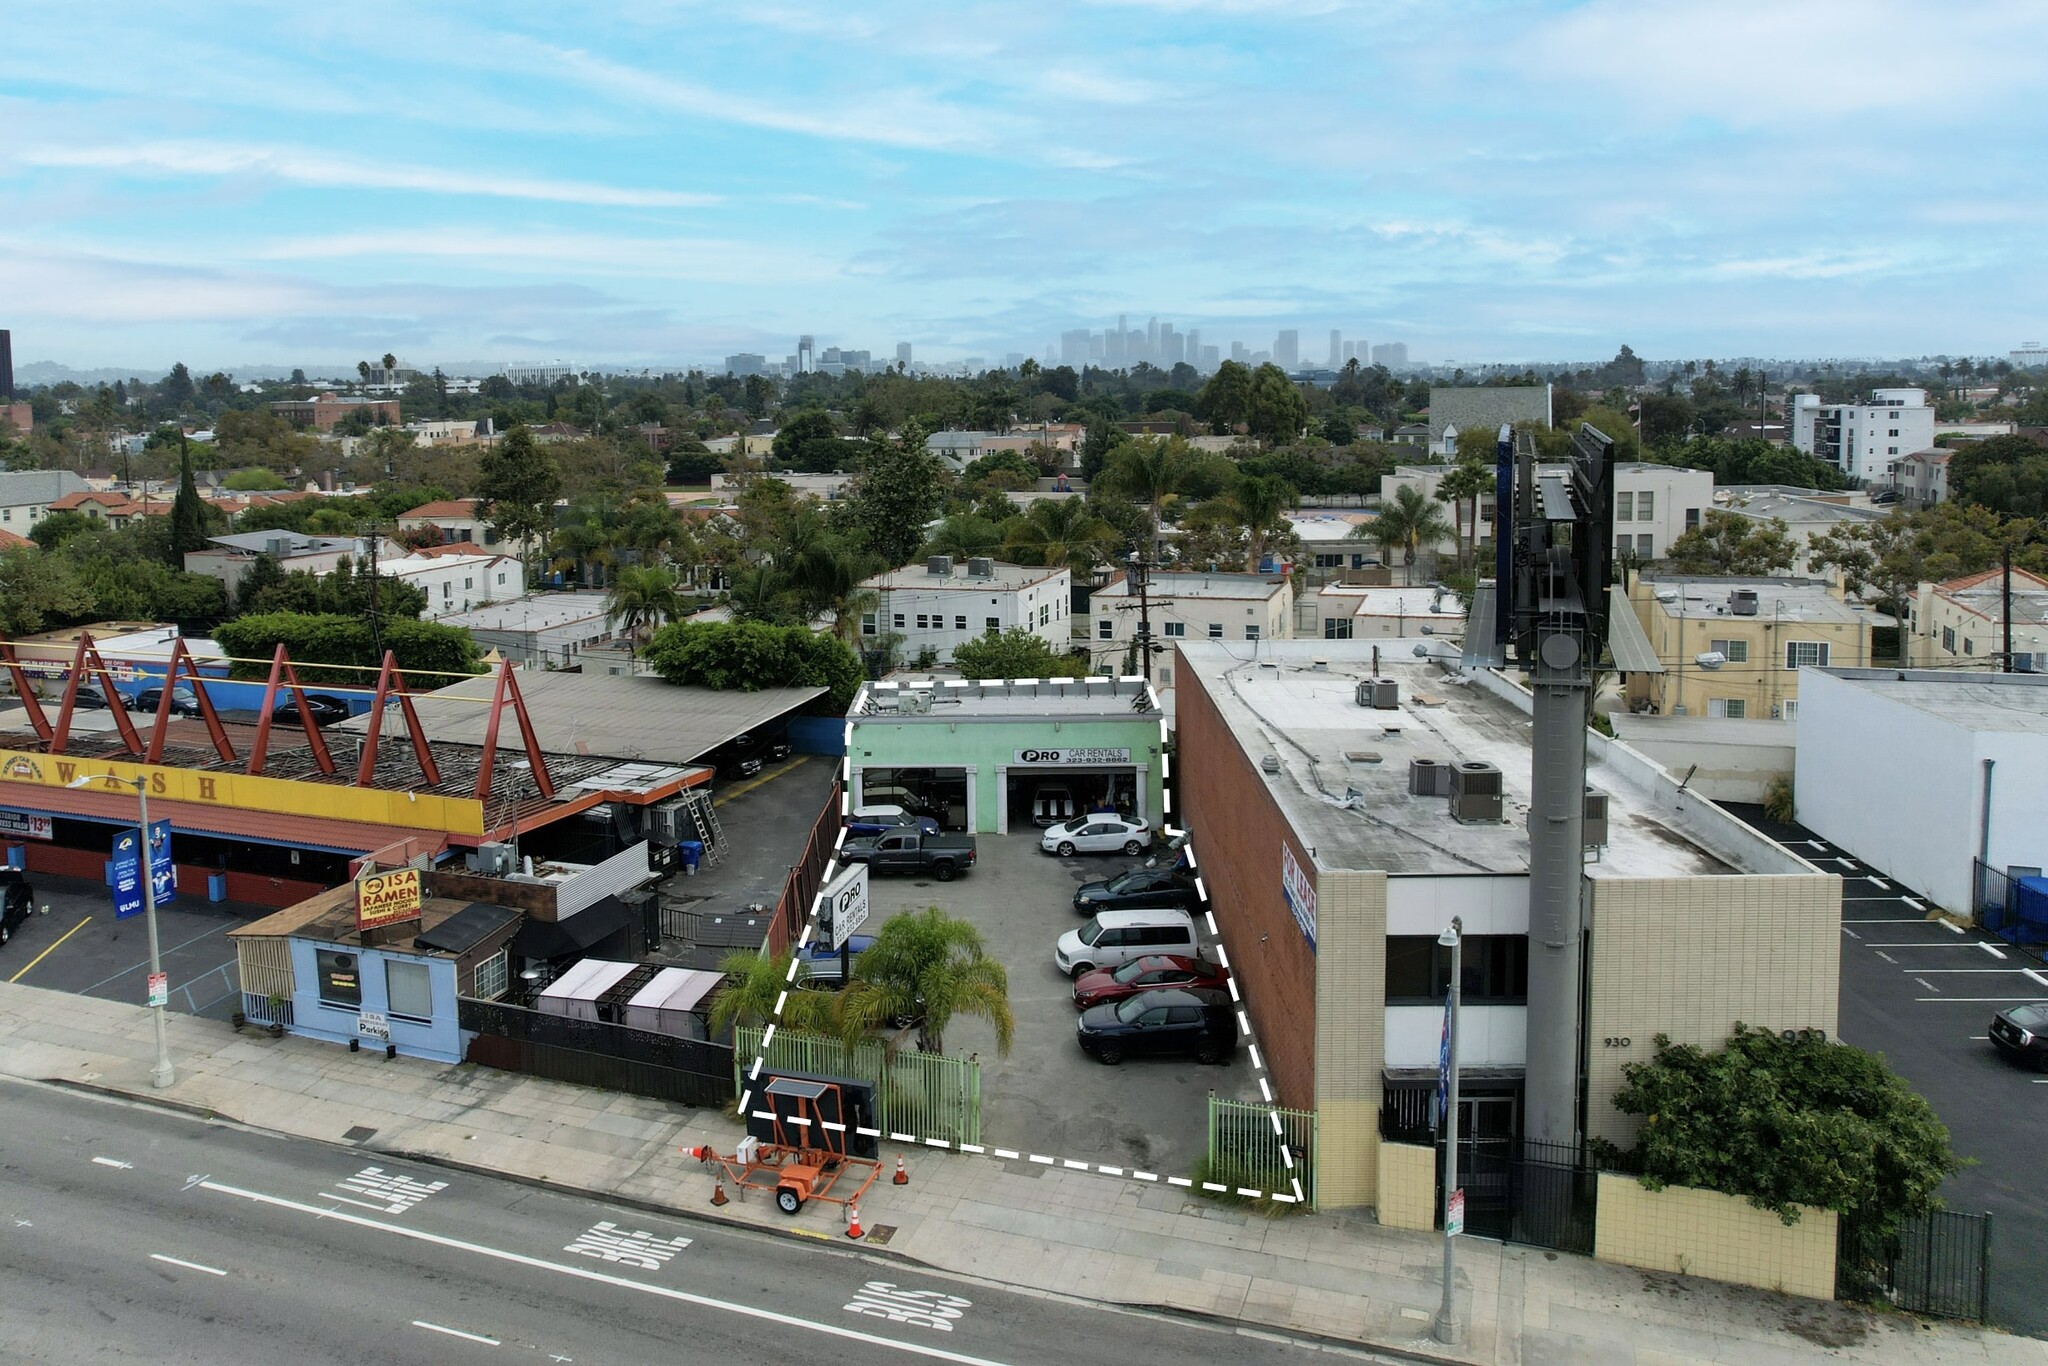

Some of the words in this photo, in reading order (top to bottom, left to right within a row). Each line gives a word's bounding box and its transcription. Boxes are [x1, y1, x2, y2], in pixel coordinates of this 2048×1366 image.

[1021, 750, 1060, 762] PRO
[1068, 749, 1085, 758] CAR
[1087, 749, 1123, 758] RENTALS
[388, 871, 417, 887] ISA
[125, 900, 140, 911] LMU
[363, 886, 418, 907] RAMEN
[839, 881, 861, 913] PRO
[835, 919, 845, 936] CAR
[846, 900, 866, 923] RENTALS
[360, 1023, 389, 1040] Parking
[1604, 1037, 1631, 1047] 930
[318, 1166, 450, 1215] LANE
[563, 1221, 694, 1270] BIKE
[842, 1281, 973, 1332] BUS
